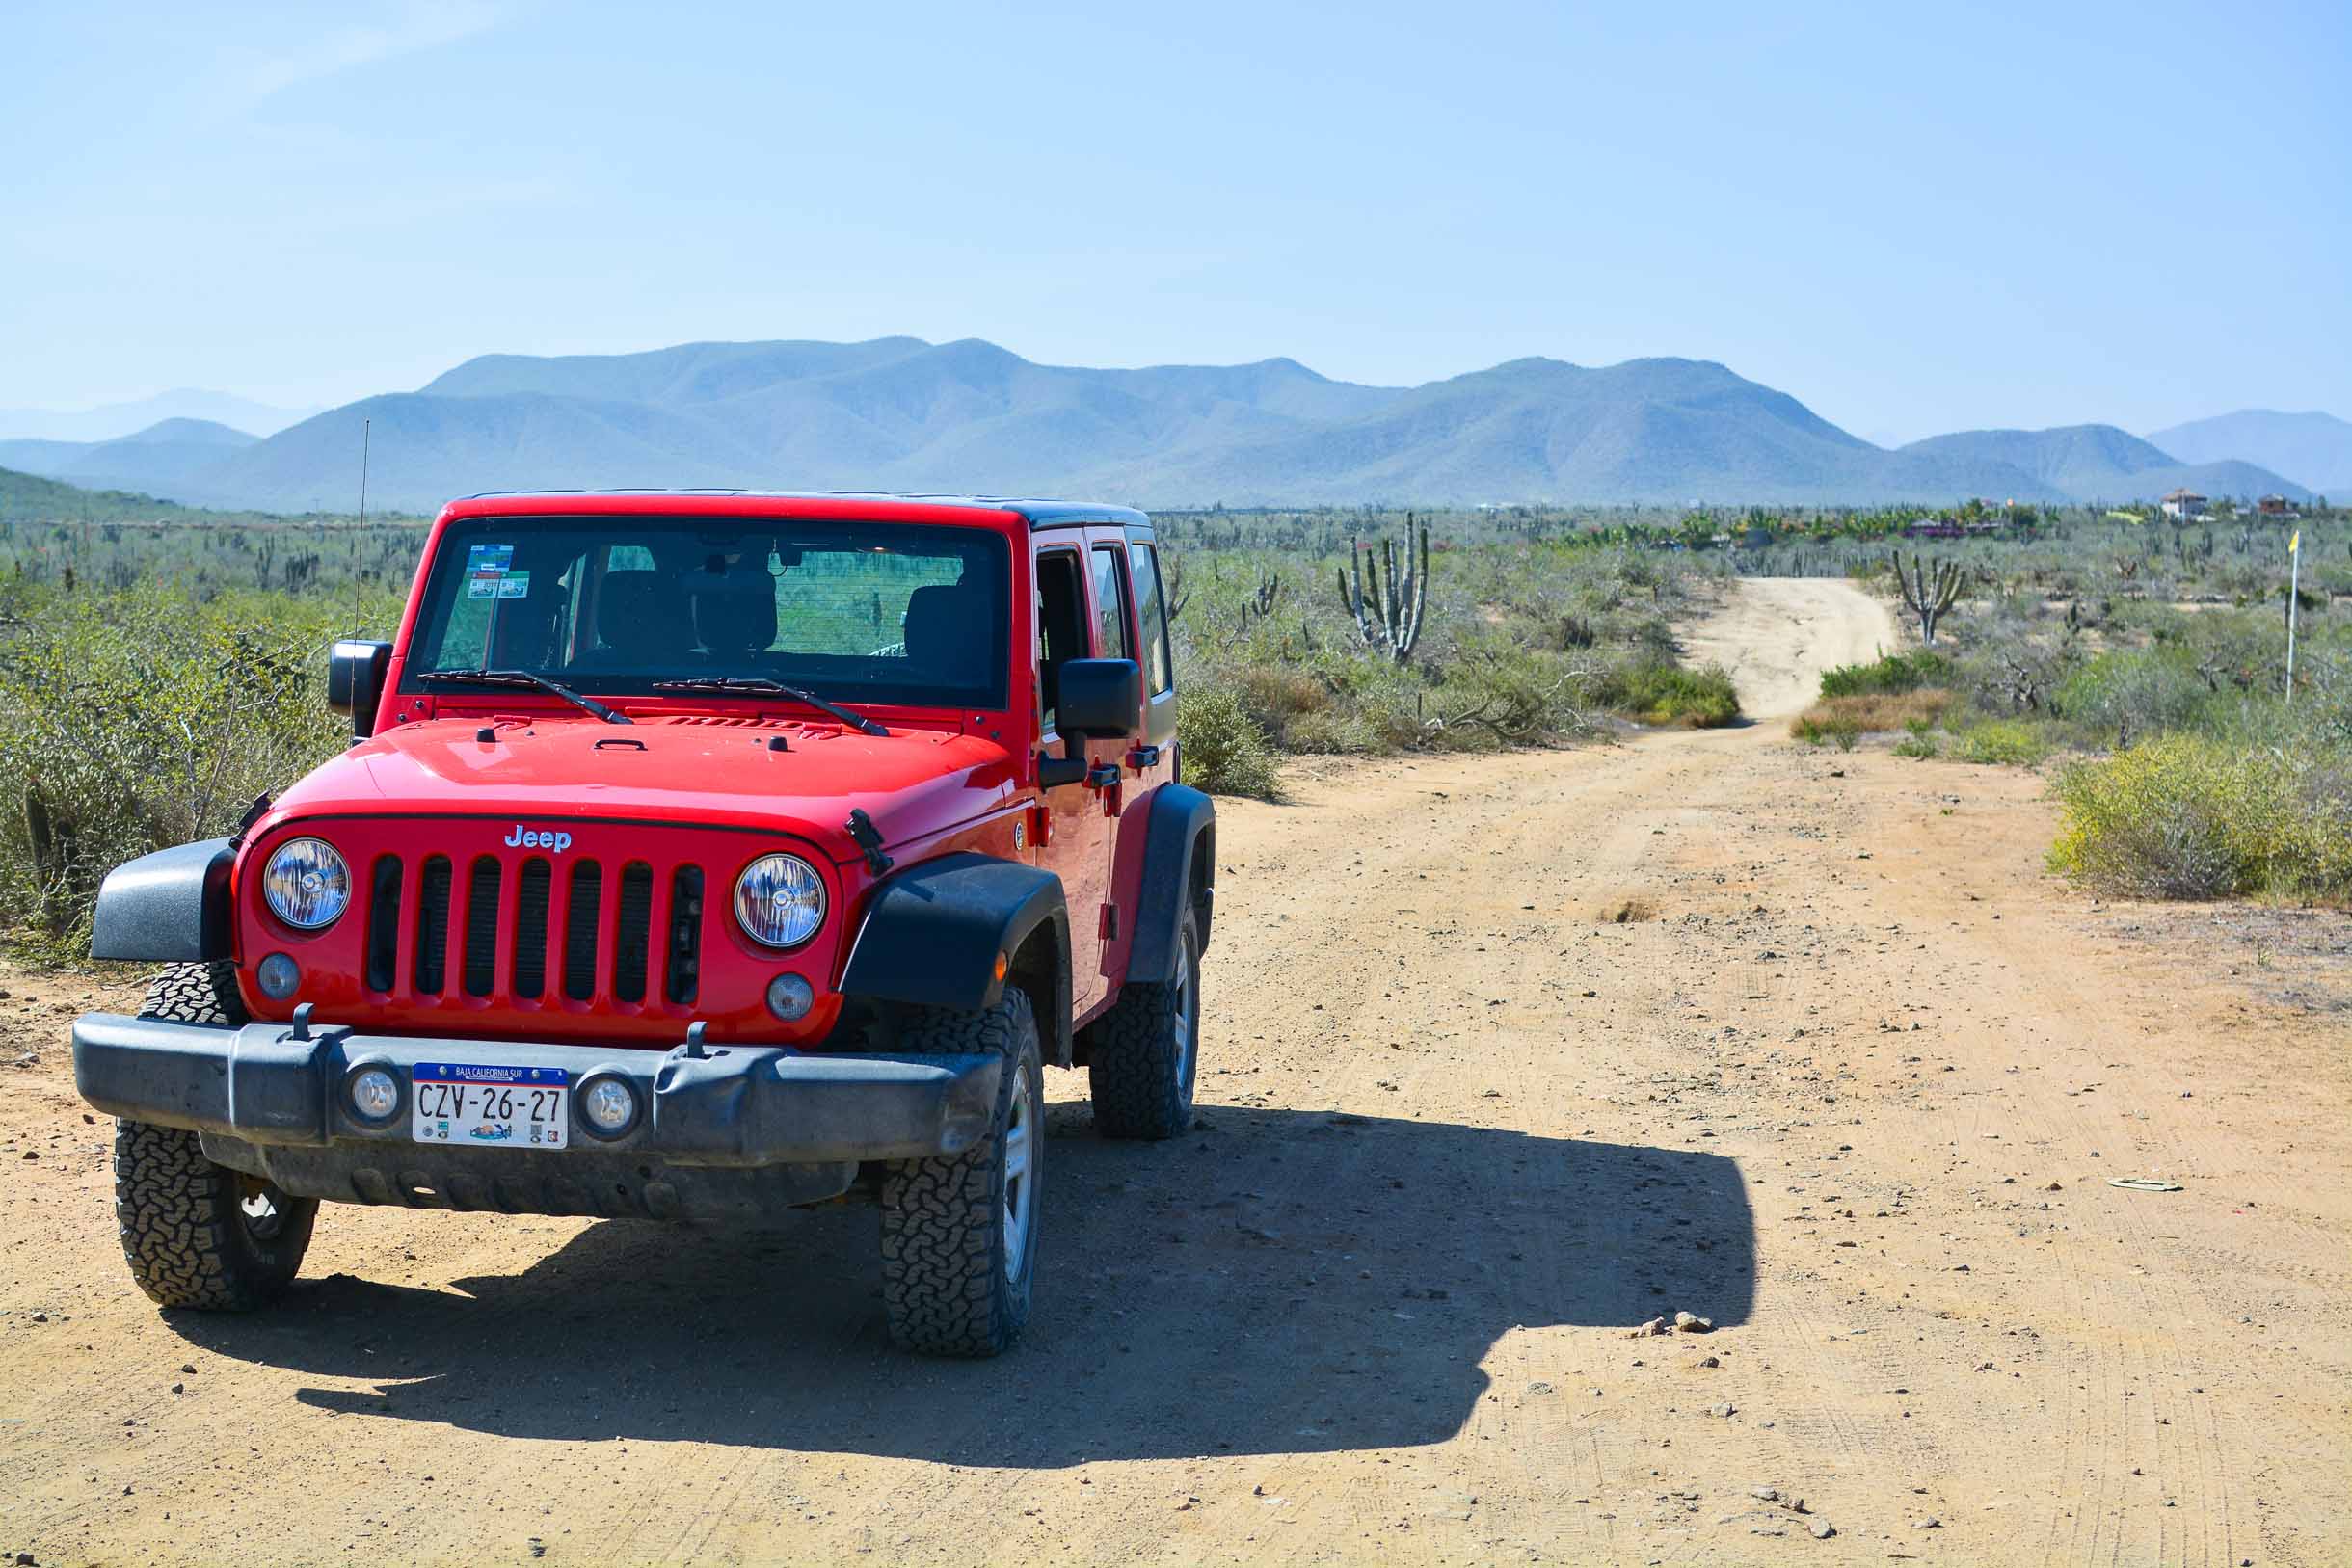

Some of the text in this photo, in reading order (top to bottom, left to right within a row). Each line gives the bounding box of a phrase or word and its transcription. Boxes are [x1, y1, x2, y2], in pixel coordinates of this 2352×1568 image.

[504, 824, 572, 853] Jeep
[455, 1066, 471, 1076] BAJA
[471, 1067, 509, 1077] CALIFORNIA
[510, 1069, 523, 1078] SUR
[418, 1084, 560, 1122] CZV-26-27
